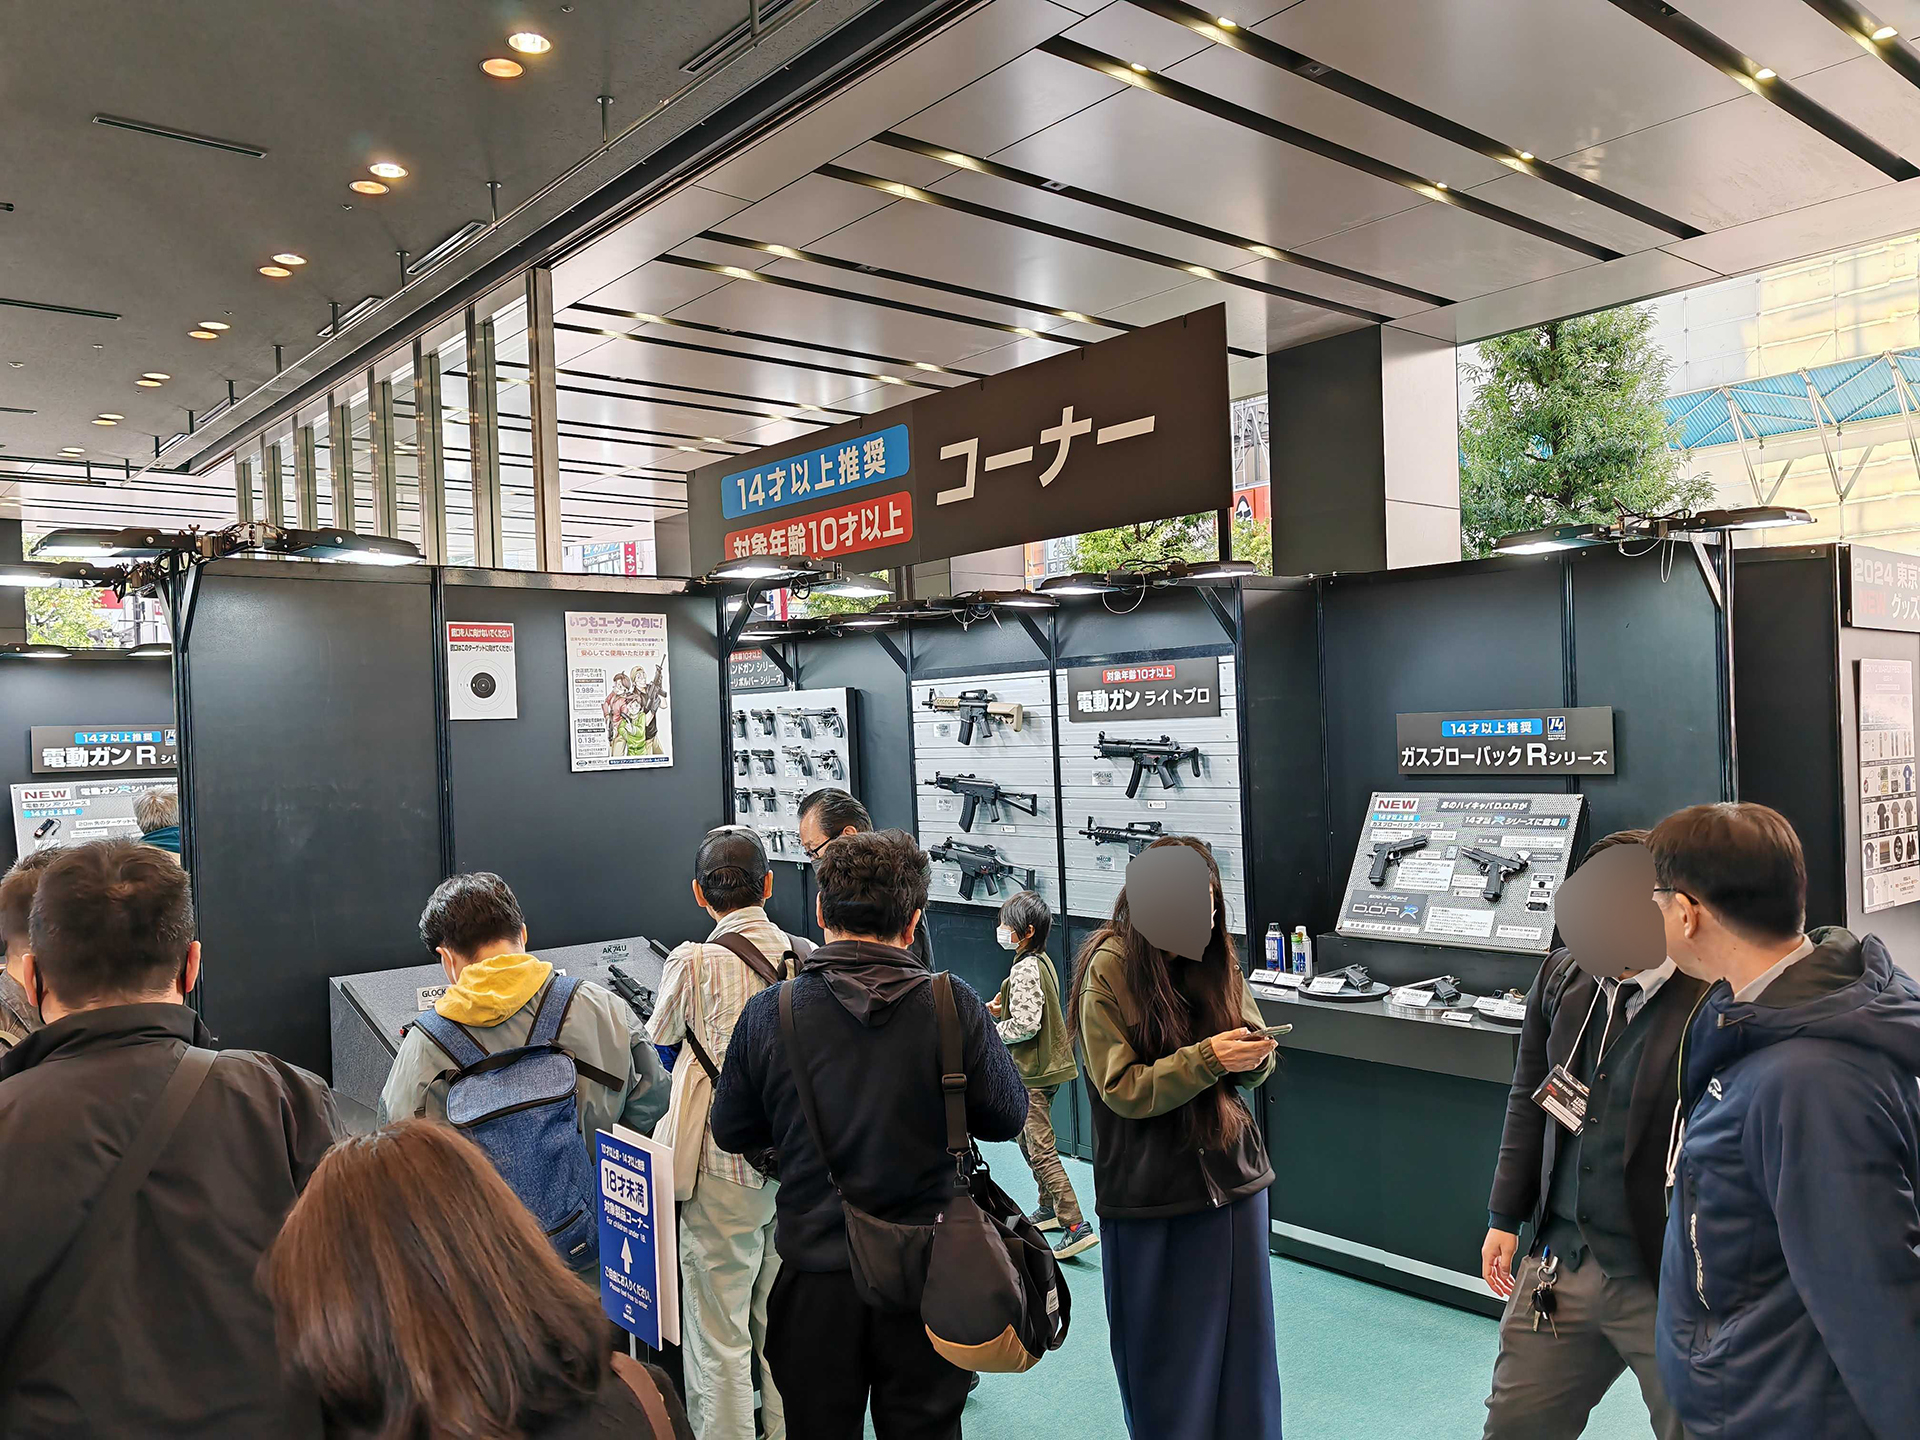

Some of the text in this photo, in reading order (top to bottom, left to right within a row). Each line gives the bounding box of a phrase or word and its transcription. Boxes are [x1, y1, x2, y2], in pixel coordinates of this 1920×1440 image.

[936, 405, 1156, 507] コーナー
[736, 437, 886, 511] 14才以上推奨
[733, 501, 904, 557] 対象年齢10才以上
[1854, 557, 1920, 590] 2024 東京
[731, 662, 755, 675] ンドガン
[1106, 667, 1173, 681] 対象年齢10才以上
[1076, 686, 1210, 713] 電動ガン ライトプロ
[1450, 721, 1533, 736] 14才以上推奨
[83, 732, 153, 743] 14才以上推奨
[24, 790, 67, 799] NEW
[1378, 800, 1417, 810] NEW
[421, 988, 447, 998] GLOCK
[604, 1167, 645, 1208] 18才未満
